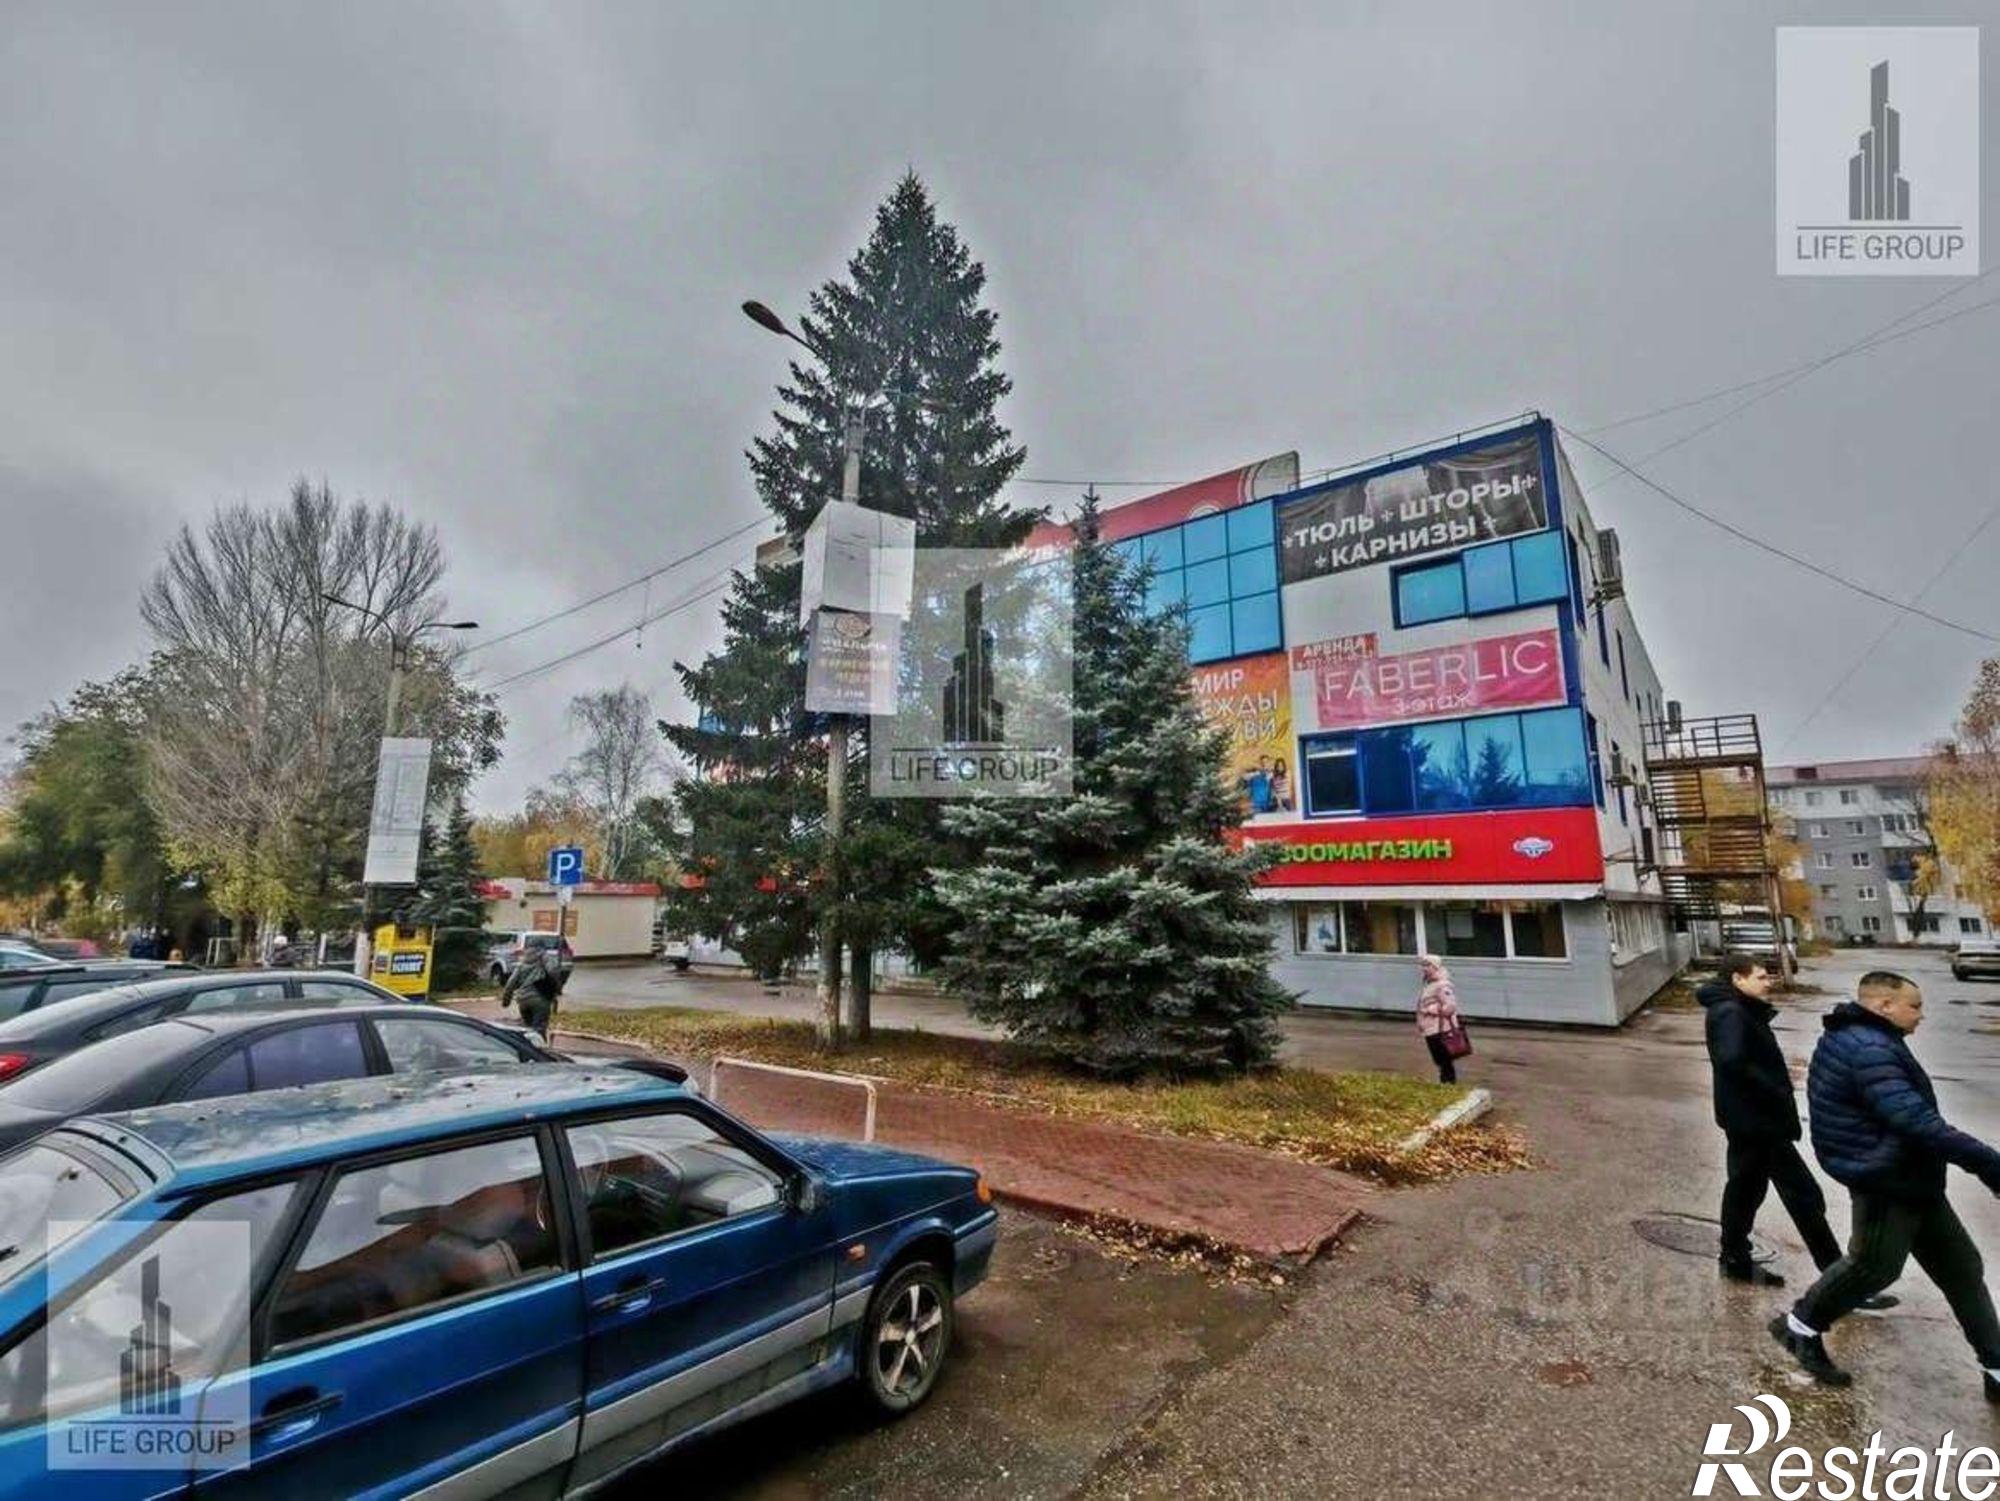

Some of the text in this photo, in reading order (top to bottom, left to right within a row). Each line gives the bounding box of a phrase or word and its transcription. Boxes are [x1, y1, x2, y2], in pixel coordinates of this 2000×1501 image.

[1294, 473, 1521, 548] ТЮЛЬ ШТОРЫ
[1331, 515, 1476, 568] КАРНИЗЫ
[1191, 668, 1244, 693] МИР
[1325, 639, 1549, 701] FABERLIC
[1202, 689, 1278, 719] ЕЖДЫ
[555, 852, 576, 884] P
